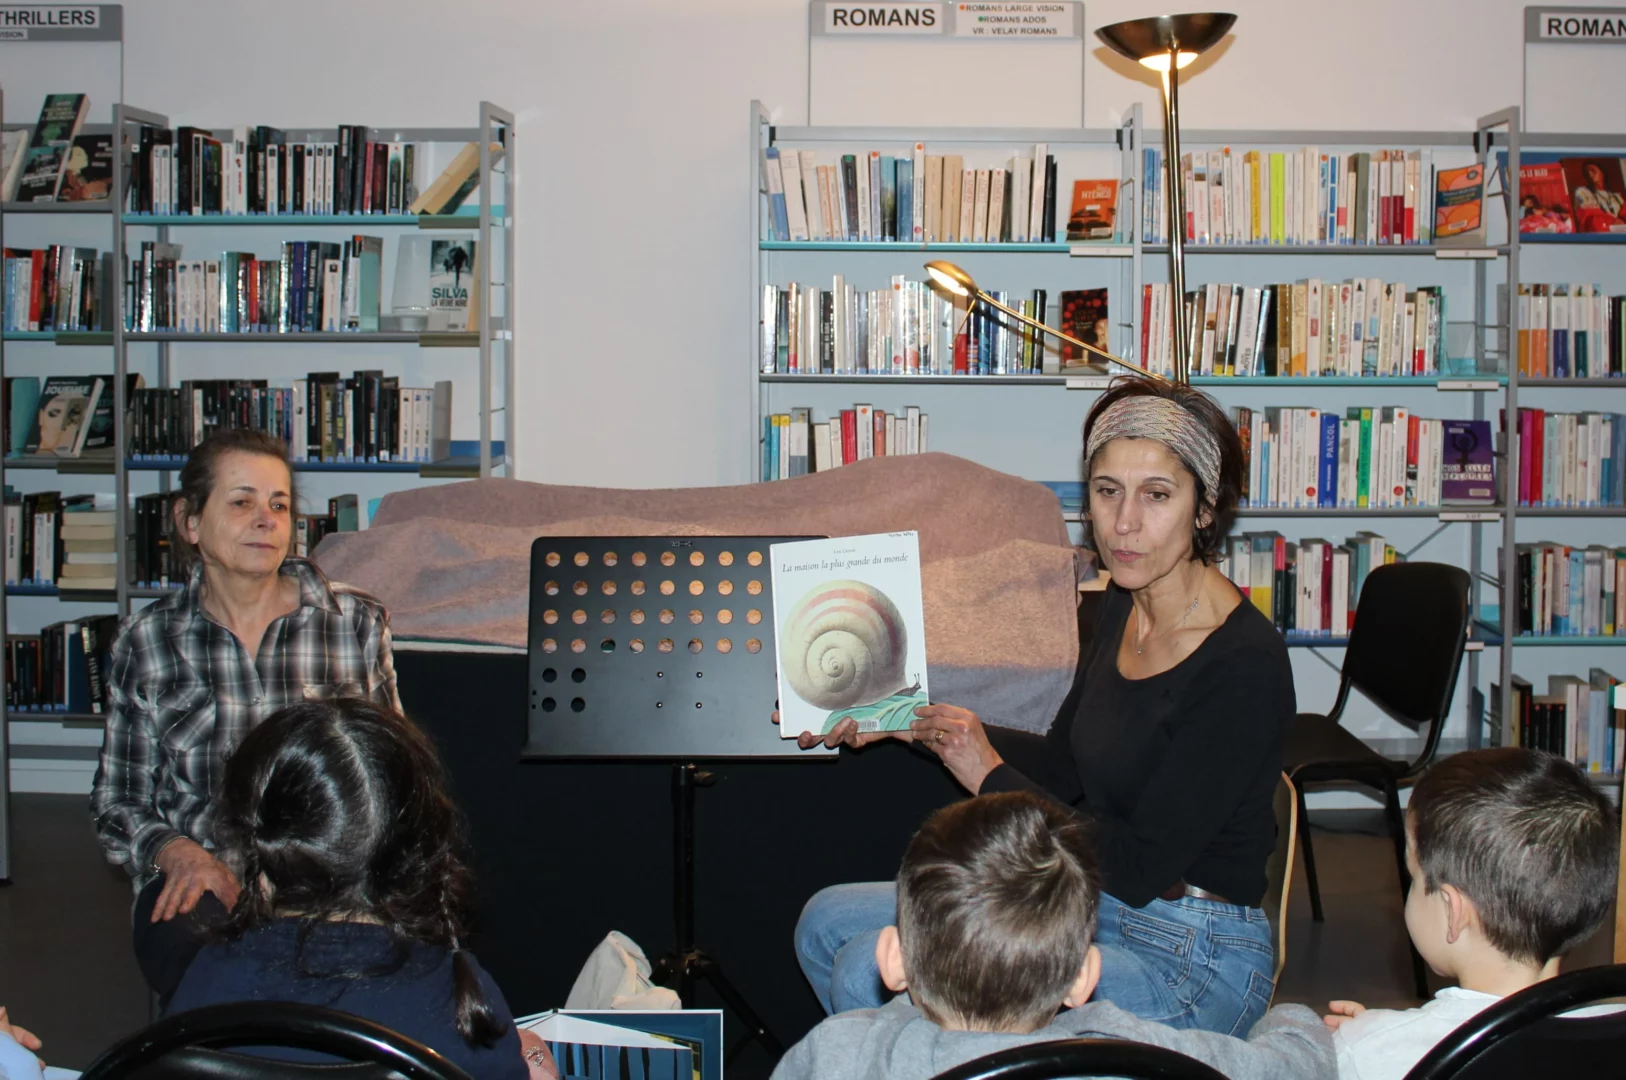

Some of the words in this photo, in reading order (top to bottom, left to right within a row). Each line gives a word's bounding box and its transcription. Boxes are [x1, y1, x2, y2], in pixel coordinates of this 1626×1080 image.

[966, 4, 1003, 12] ROMANS
[1005, 4, 1033, 12] LARGE
[1036, 4, 1065, 12] VISION
[832, 8, 936, 26] ROMANS
[984, 15, 1021, 23] ROMANS
[1023, 15, 1047, 23] ADOS
[972, 27, 984, 35] VR
[991, 27, 1018, 35] VELAY
[1020, 27, 1058, 35] ROMANS
[431, 287, 468, 299] SILVA
[1326, 423, 1335, 458] PANCOL
[782, 563, 793, 572] La
[794, 561, 819, 571] maison
[821, 560, 828, 569] la
[829, 558, 845, 571] plus
[846, 556, 871, 569] grande
[872, 555, 882, 564] du
[883, 553, 909, 563] monde
